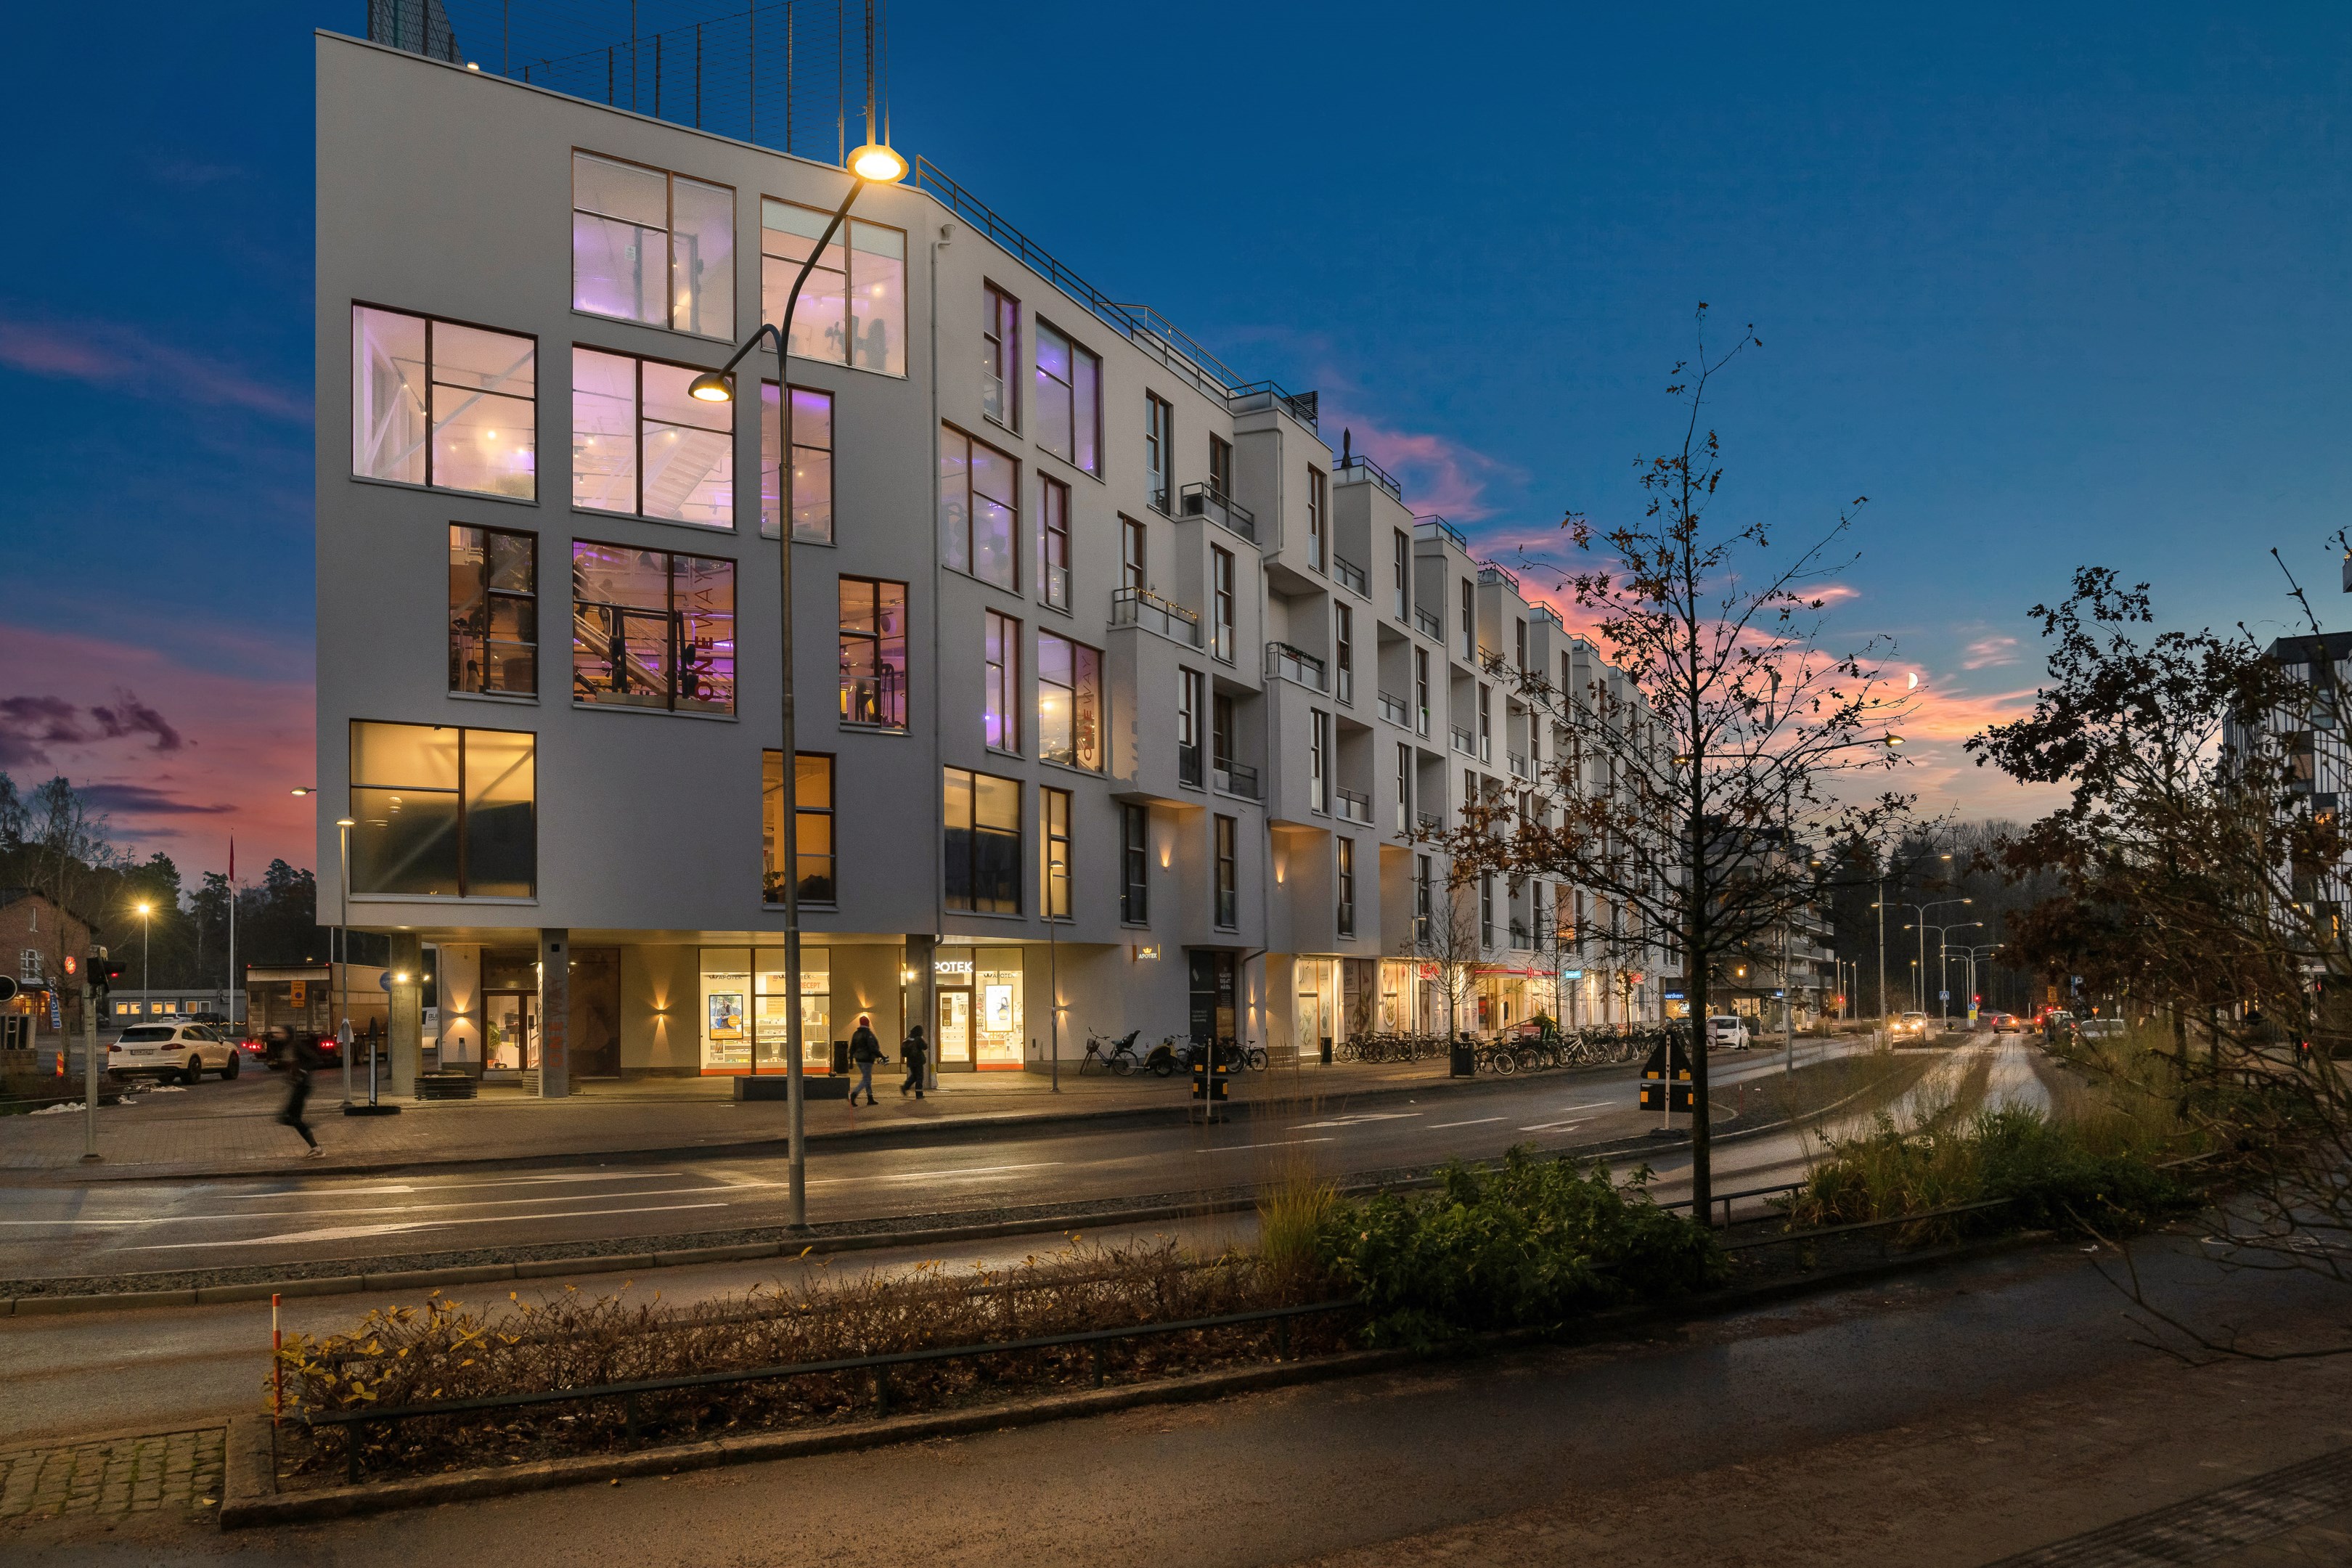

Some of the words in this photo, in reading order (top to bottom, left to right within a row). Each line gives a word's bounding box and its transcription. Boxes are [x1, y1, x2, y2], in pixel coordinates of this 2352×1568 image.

[694, 568, 714, 628] WAY
[694, 636, 714, 701] ONE
[1082, 656, 1092, 704] WAY
[934, 961, 973, 972] POTEK
[1420, 963, 1440, 975] ICA
[547, 975, 564, 1018] WAY
[547, 1021, 564, 1068] ONE
